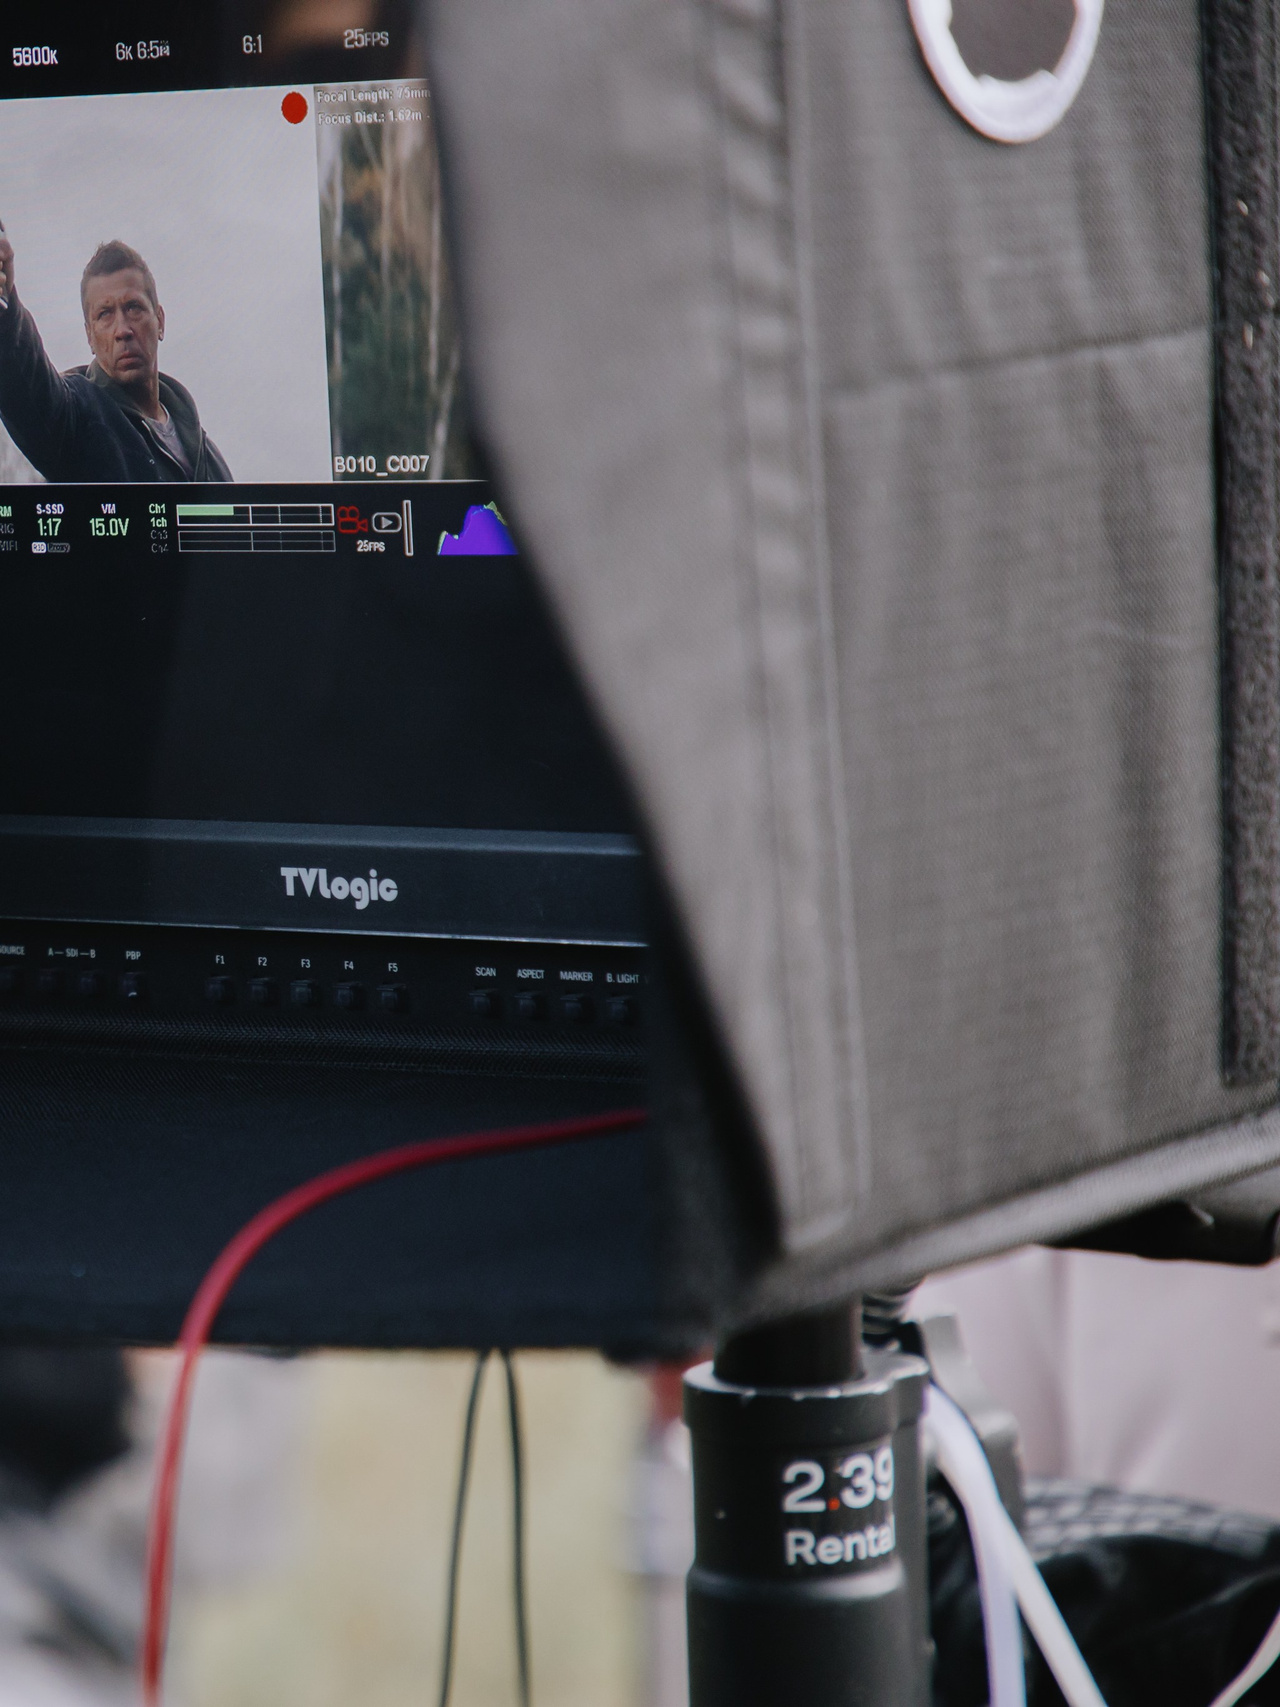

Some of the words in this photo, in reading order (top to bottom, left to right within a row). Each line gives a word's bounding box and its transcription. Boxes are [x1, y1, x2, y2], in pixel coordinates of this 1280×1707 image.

[242, 34, 263, 54] 6:1
[344, 28, 389, 48] 25FPS
[317, 90, 347, 103] Focal
[351, 88, 393, 104] Length:
[318, 112, 352, 125] Focus
[355, 110, 385, 123] Dist.:
[389, 109, 422, 121] 1.62m
[334, 455, 430, 477] B010_C007
[36, 503, 64, 515] S-SSD
[148, 503, 166, 514] Ch1
[37, 518, 62, 536] 1:17
[89, 518, 129, 536] 15.0V
[357, 540, 385, 552] 25FPS
[48, 947, 54, 956] A
[66, 948, 79, 958] SDI
[90, 949, 96, 959] B
[125, 951, 141, 960] PBP
[215, 955, 225, 965] F1
[258, 957, 267, 967] F2
[301, 959, 311, 968] F3
[344, 961, 354, 970] F4
[388, 963, 398, 972] F5
[475, 967, 496, 977] SCAN
[517, 968, 545, 979] ASPECT
[559, 970, 593, 982] MARKER
[606, 973, 615, 983] B.
[617, 973, 639, 984] LIGHT
[782, 1446, 895, 1513] 2.39
[785, 1512, 896, 1566] Rental
